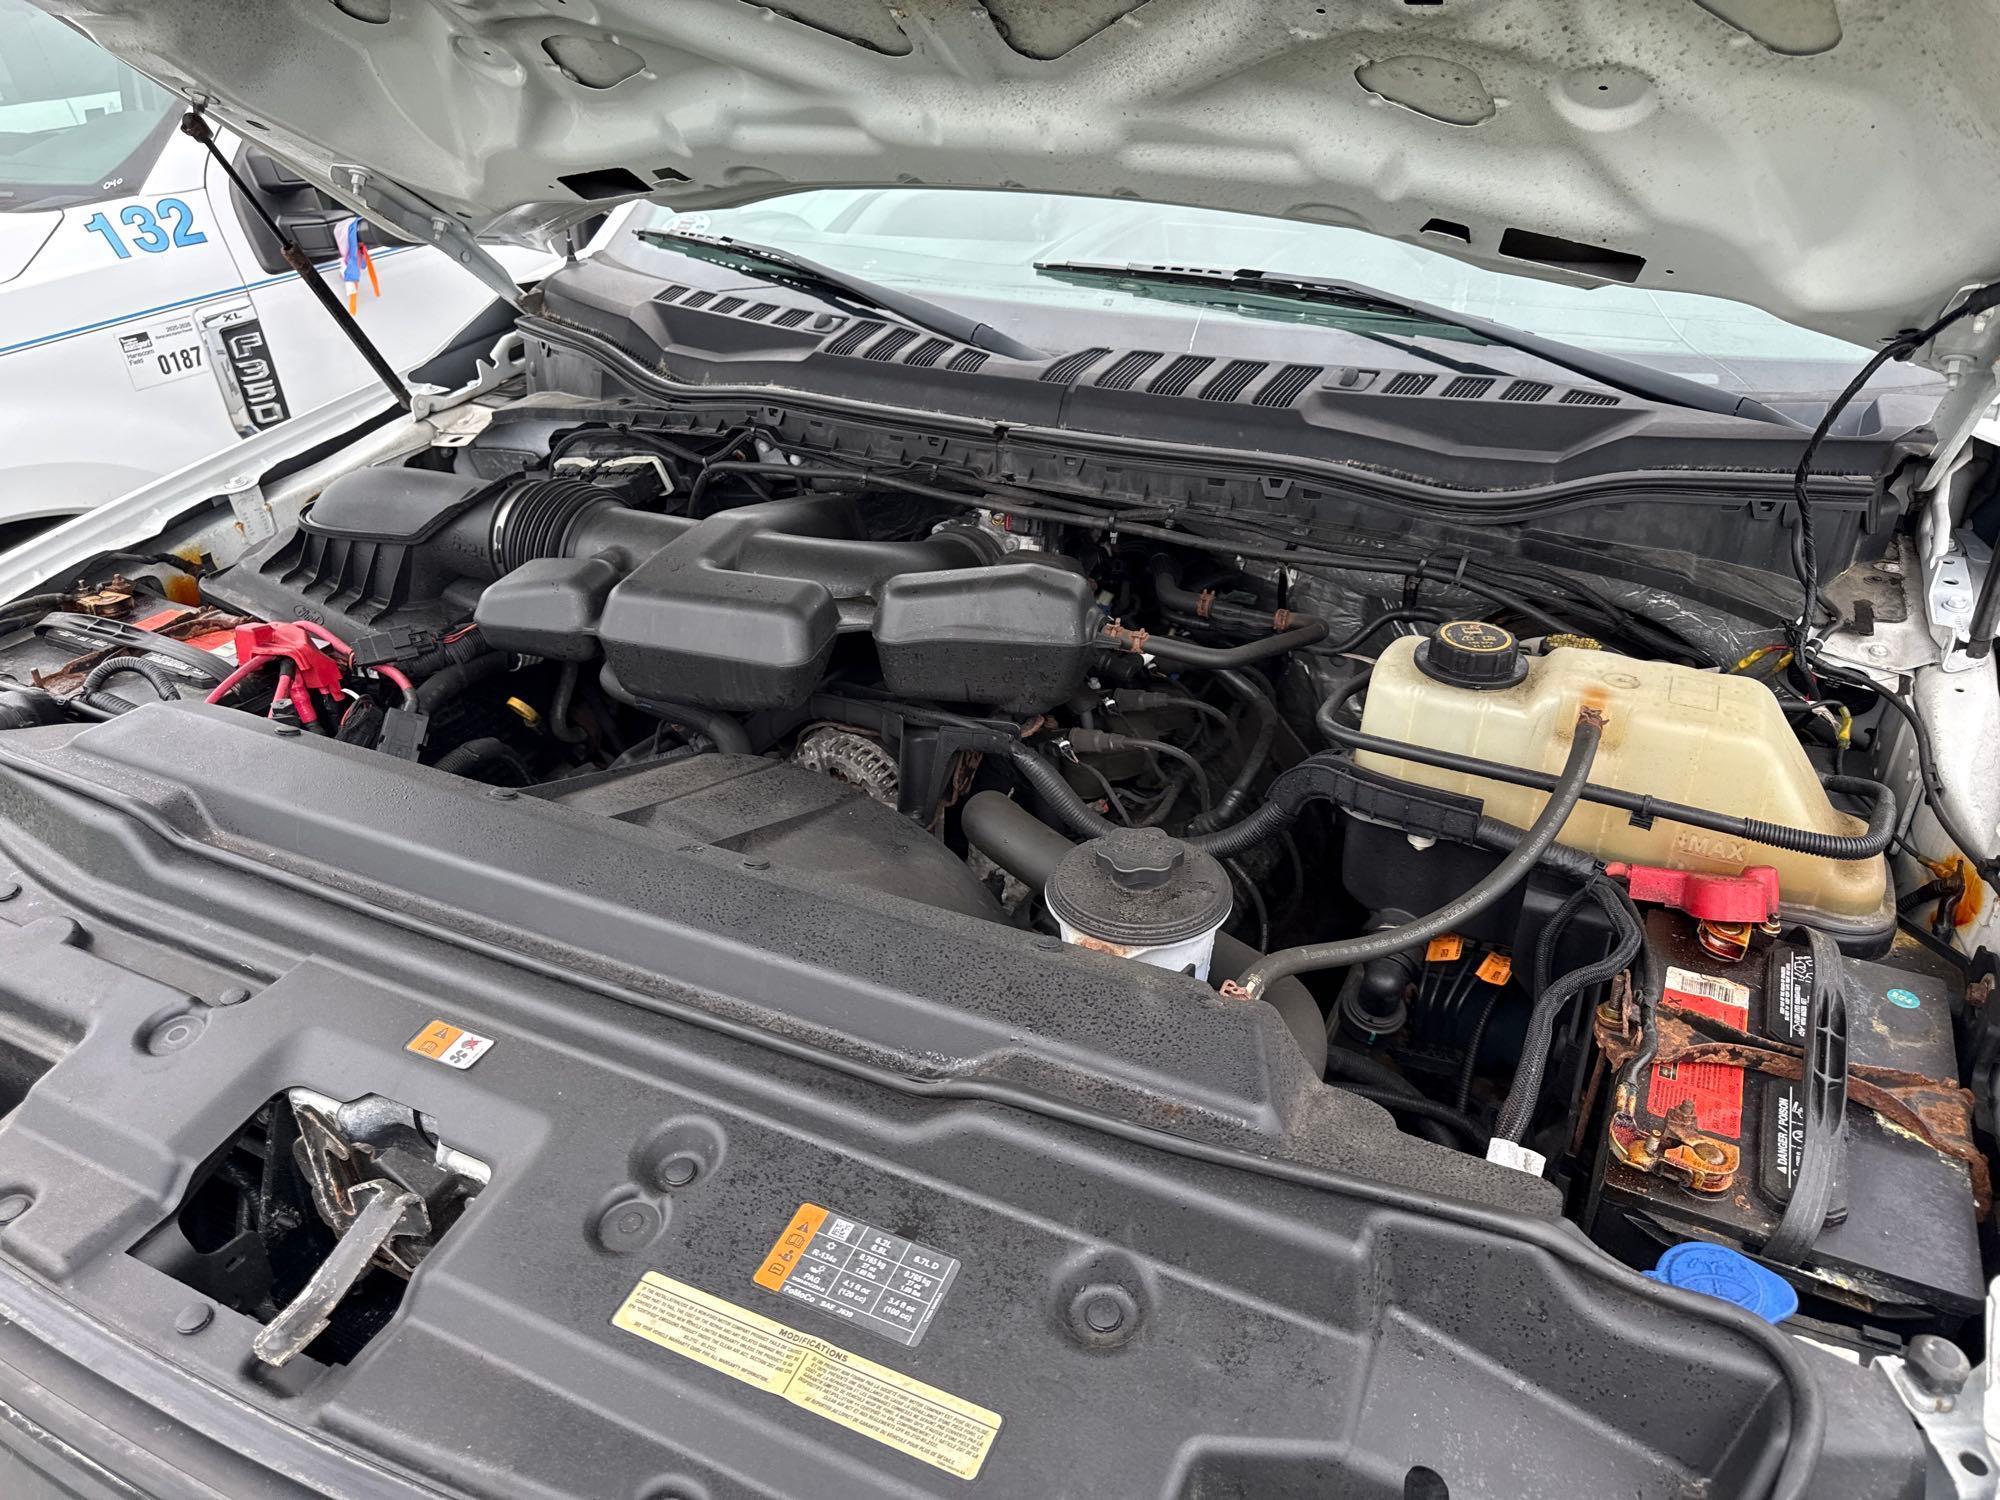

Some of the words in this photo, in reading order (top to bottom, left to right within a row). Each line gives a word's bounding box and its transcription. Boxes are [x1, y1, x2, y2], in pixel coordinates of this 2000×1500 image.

[84, 198, 208, 259] 132
[223, 313, 242, 322] XL
[157, 346, 202, 375] 0187
[1688, 836, 1746, 861] MAX
[1778, 1098, 1788, 1126] POISON
[1778, 1129, 1788, 1166] DANGER
[811, 1249, 838, 1264] R-134a
[913, 1256, 932, 1268] 6.7L
[803, 1272, 821, 1285] PAG
[782, 1285, 816, 1303] FoMoCo
[819, 1300, 836, 1311] SAE
[778, 1328, 850, 1363] MODIFICATIONS
